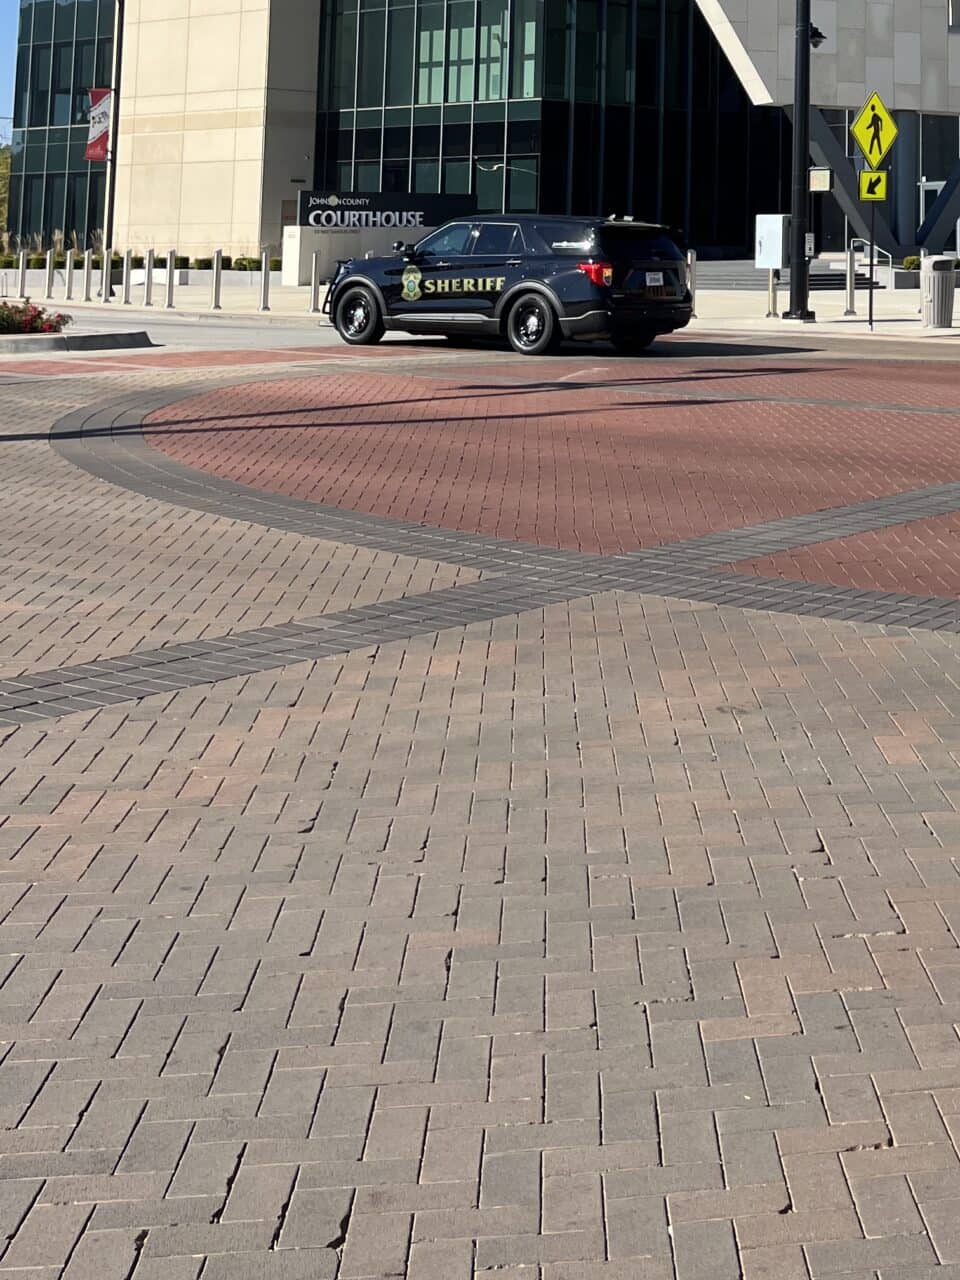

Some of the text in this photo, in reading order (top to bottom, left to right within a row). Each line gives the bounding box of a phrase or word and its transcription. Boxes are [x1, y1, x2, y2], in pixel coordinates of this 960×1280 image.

[342, 198, 369, 206] COUNTY
[308, 210, 424, 227] COURTHOUSE
[423, 277, 506, 294] SHERIFF
